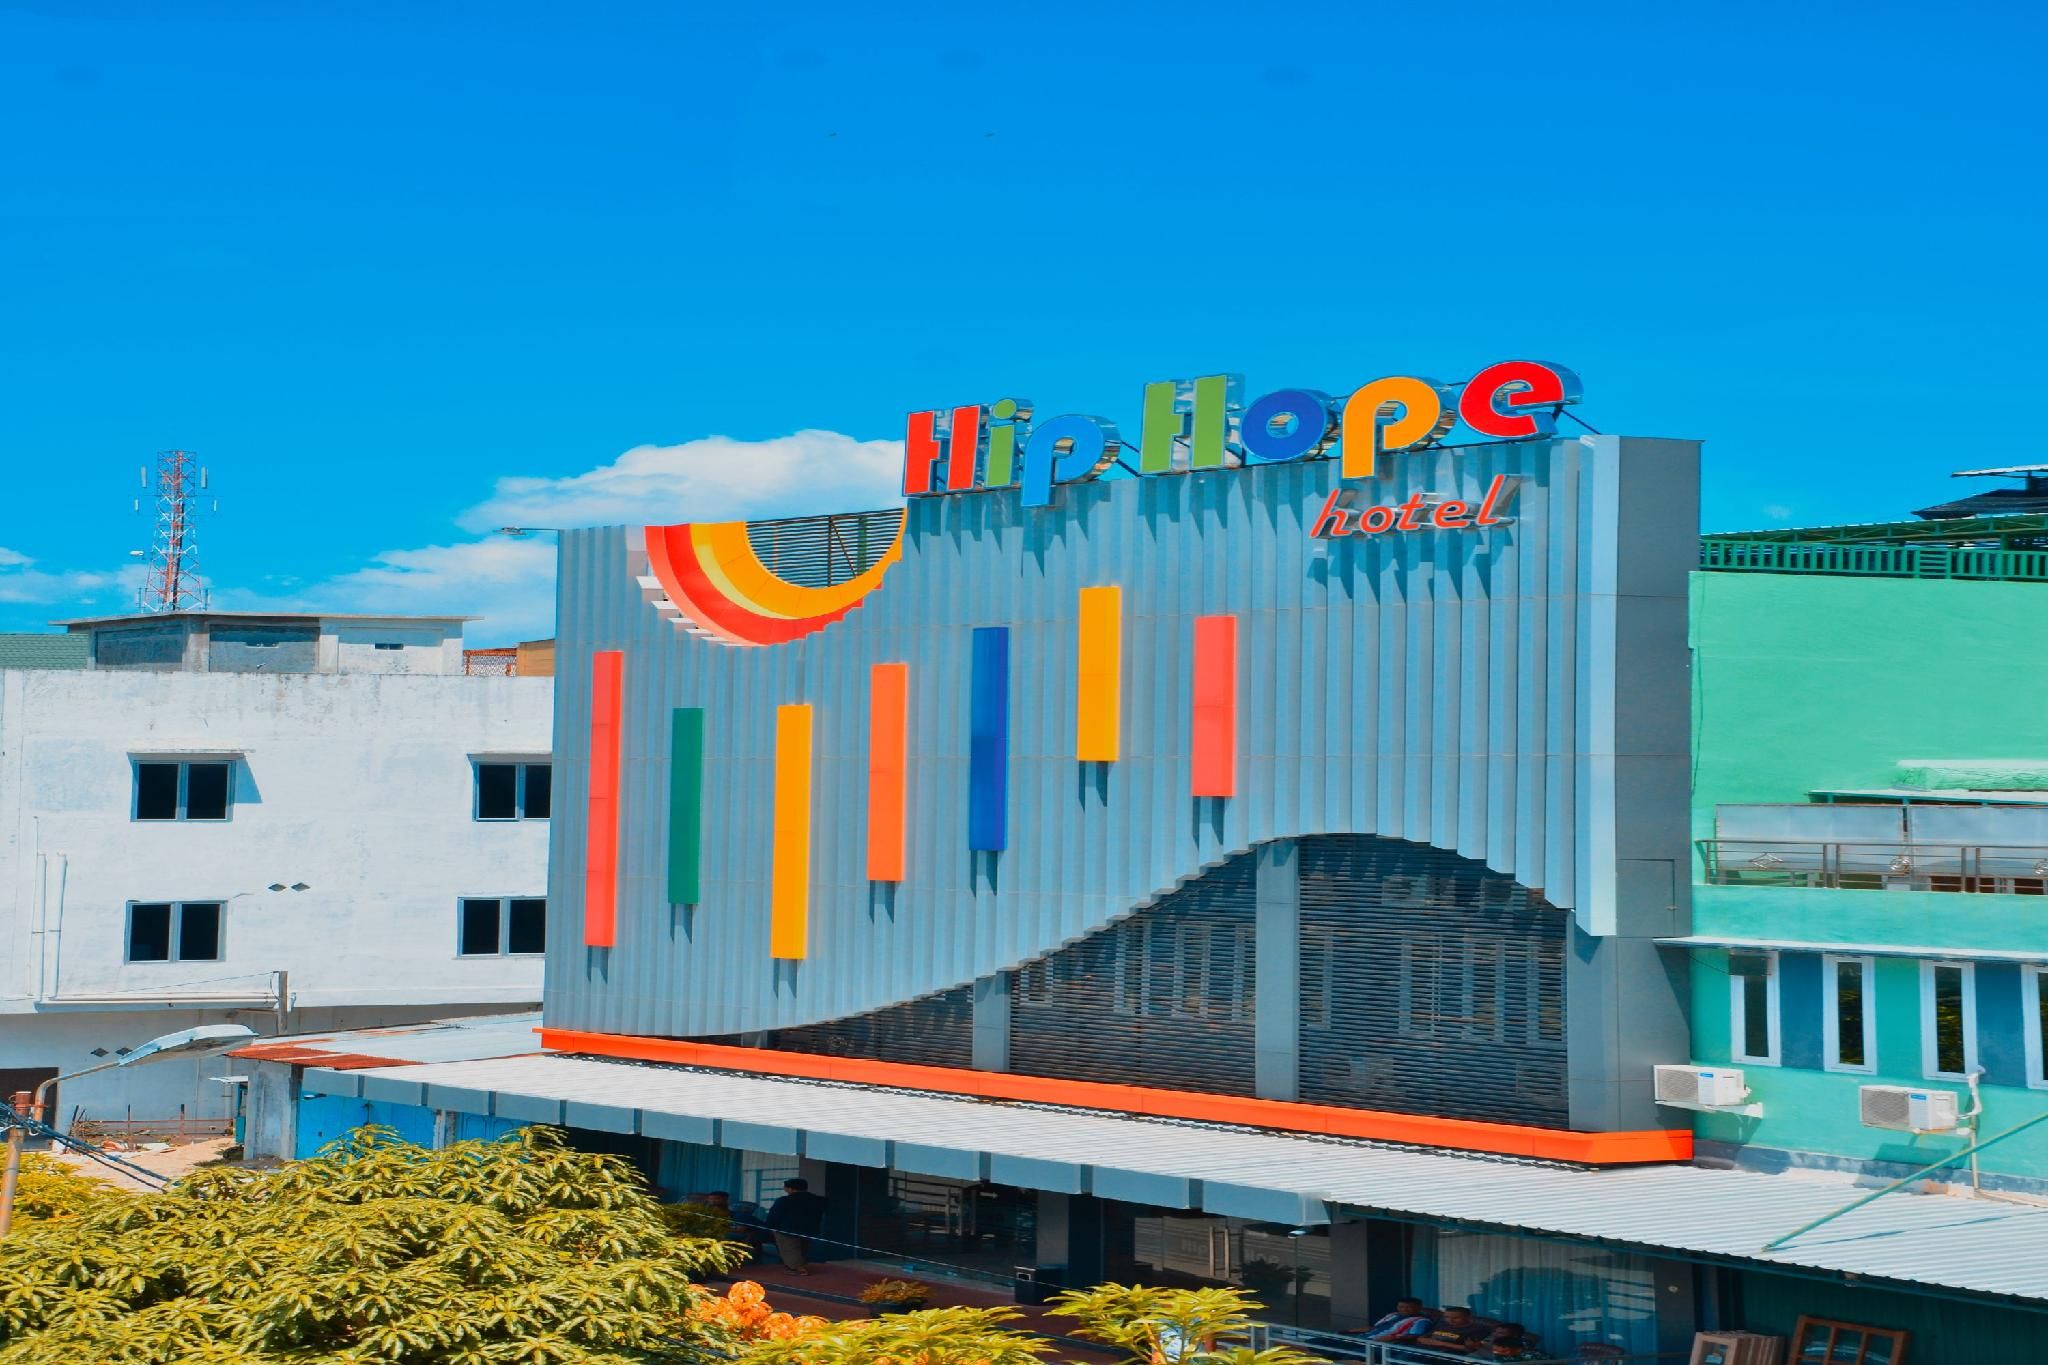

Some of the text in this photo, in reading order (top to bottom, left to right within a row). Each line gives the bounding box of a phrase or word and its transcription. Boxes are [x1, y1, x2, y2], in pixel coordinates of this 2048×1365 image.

[902, 360, 1568, 507] Hip Hope
[1310, 474, 1507, 538] hotel
